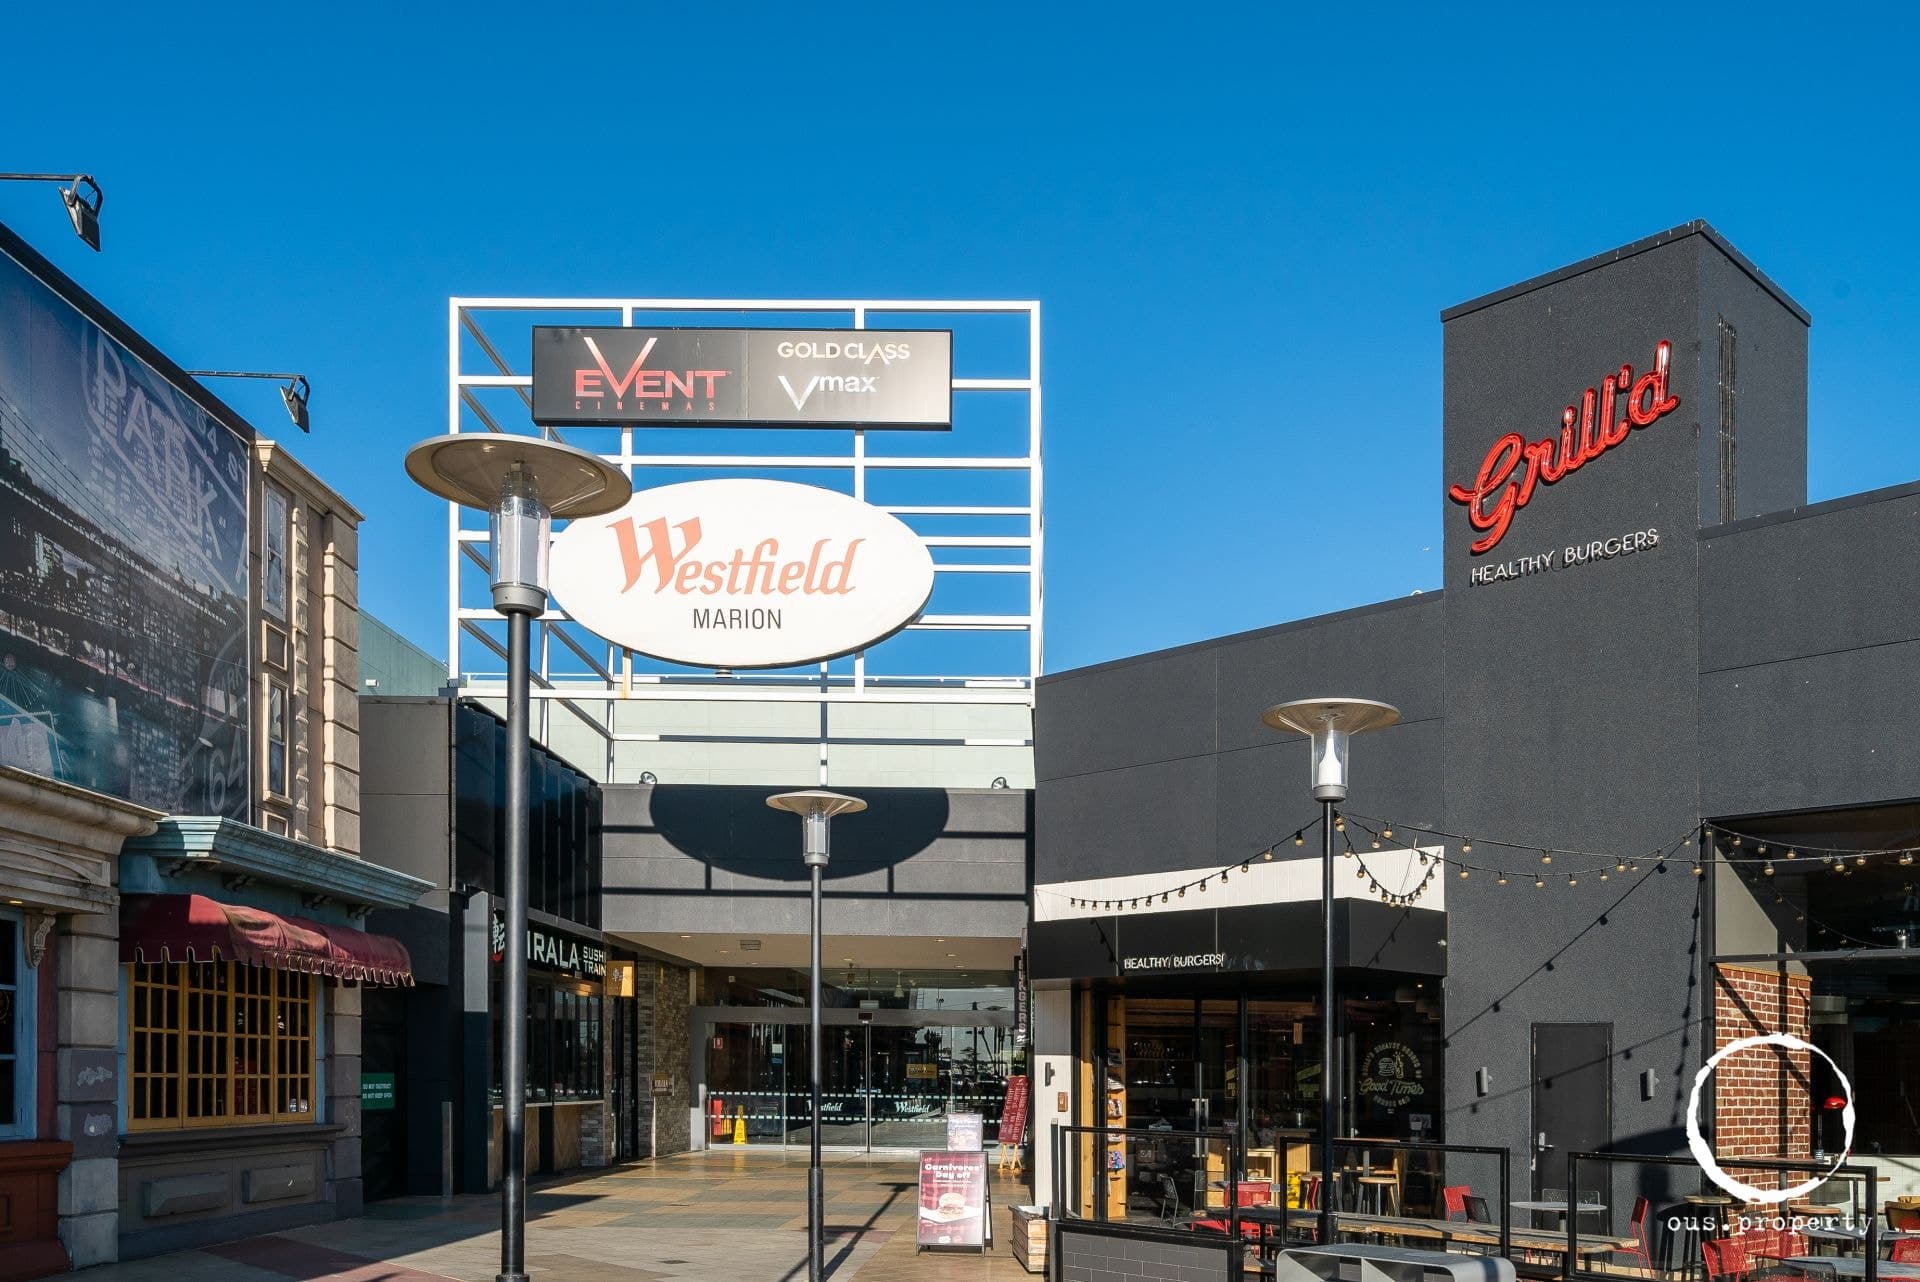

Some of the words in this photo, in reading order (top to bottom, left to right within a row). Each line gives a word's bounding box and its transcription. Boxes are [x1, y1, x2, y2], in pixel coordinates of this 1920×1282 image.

[777, 341, 841, 359] GOLD
[844, 342, 911, 365] CLASS
[575, 337, 726, 399] EVENT
[777, 375, 878, 411] Vmax
[575, 401, 715, 412] CINEMAS
[1450, 339, 1681, 555] Grill'd
[605, 516, 867, 595] Westfield
[1471, 550, 1555, 583] HEALTHY
[1565, 528, 1658, 563] BURGERS
[693, 608, 782, 630] MARION
[583, 946, 606, 963] SUSHI
[1124, 956, 1169, 970] HEALTHY
[1173, 953, 1223, 968] BURGERS
[583, 959, 607, 977] TRAIN
[894, 1101, 930, 1114] Westfield
[935, 1171, 954, 1180] Day
